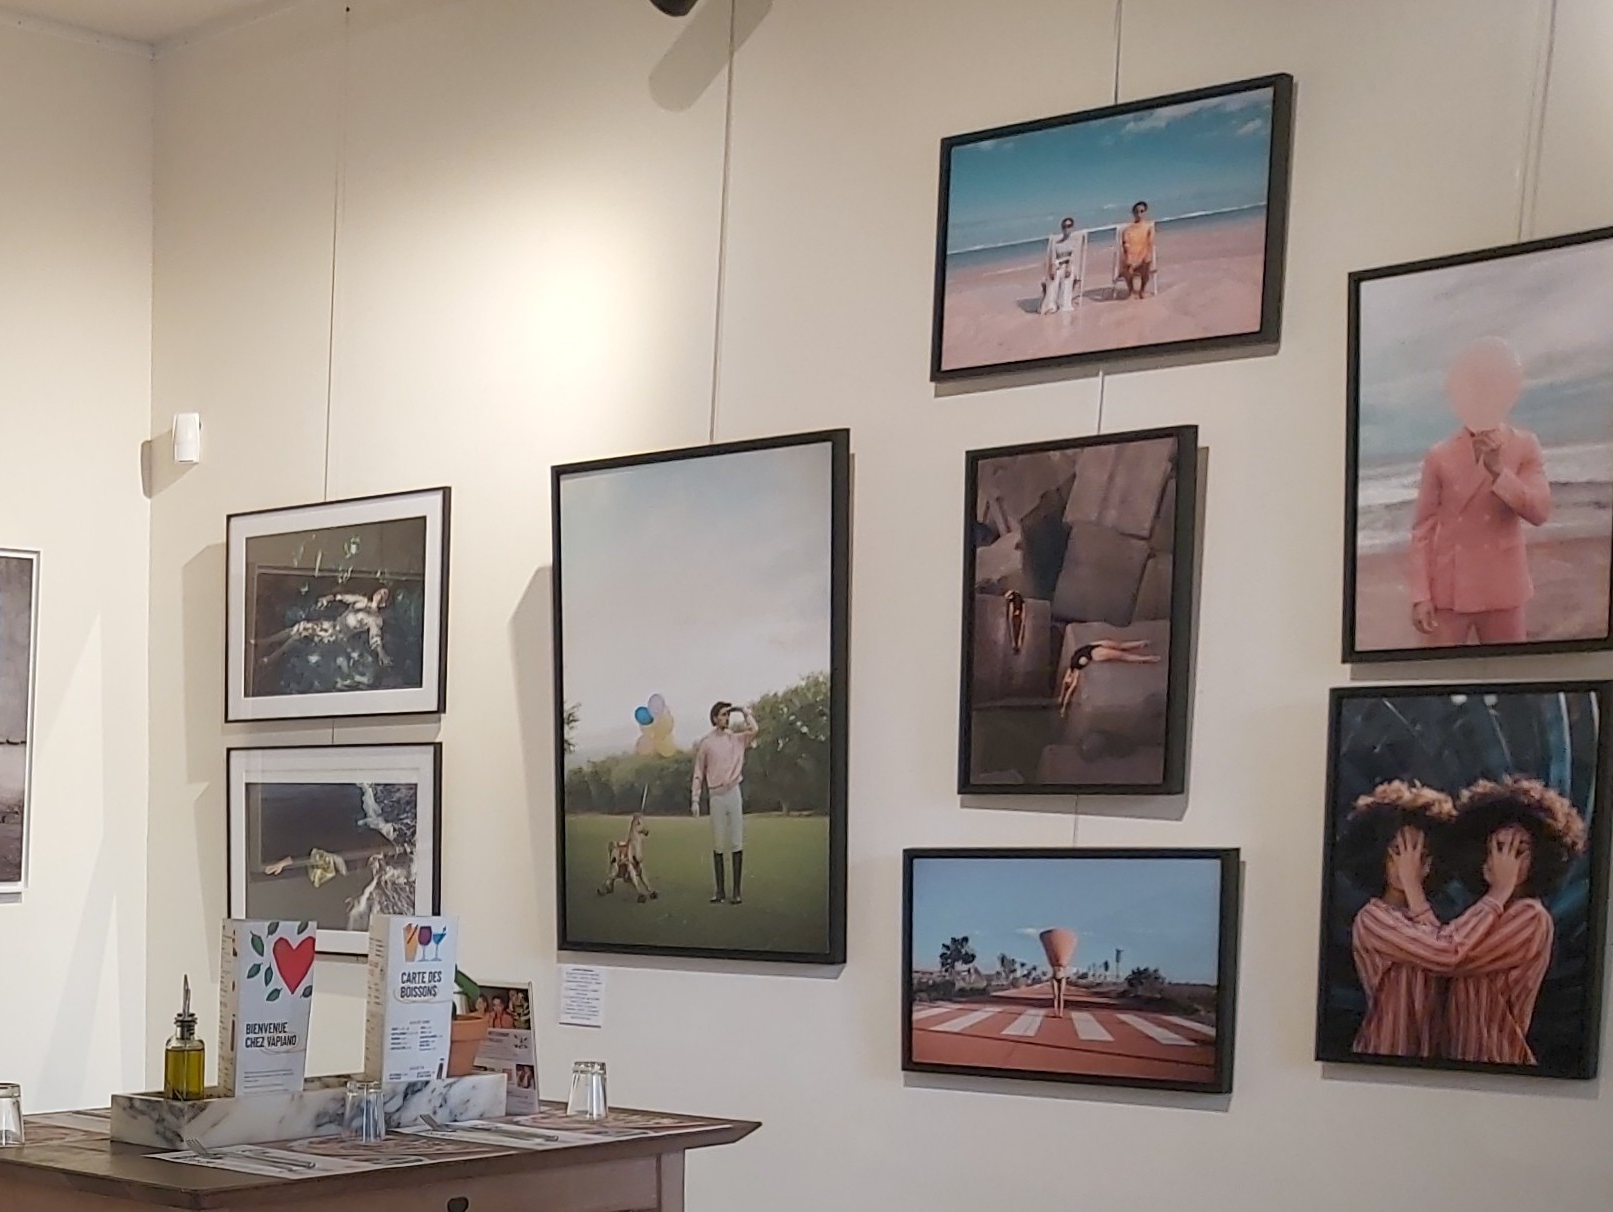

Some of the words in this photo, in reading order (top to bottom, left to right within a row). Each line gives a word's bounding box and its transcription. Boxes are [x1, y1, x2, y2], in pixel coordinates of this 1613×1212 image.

[401, 971, 427, 984] CARTE
[428, 971, 442, 983] DES
[400, 985, 438, 998] BOISSONS
[246, 1022, 288, 1034] BIENVENUE
[245, 1037, 265, 1048] CHEZ
[267, 1035, 297, 1047] VAPIANO
